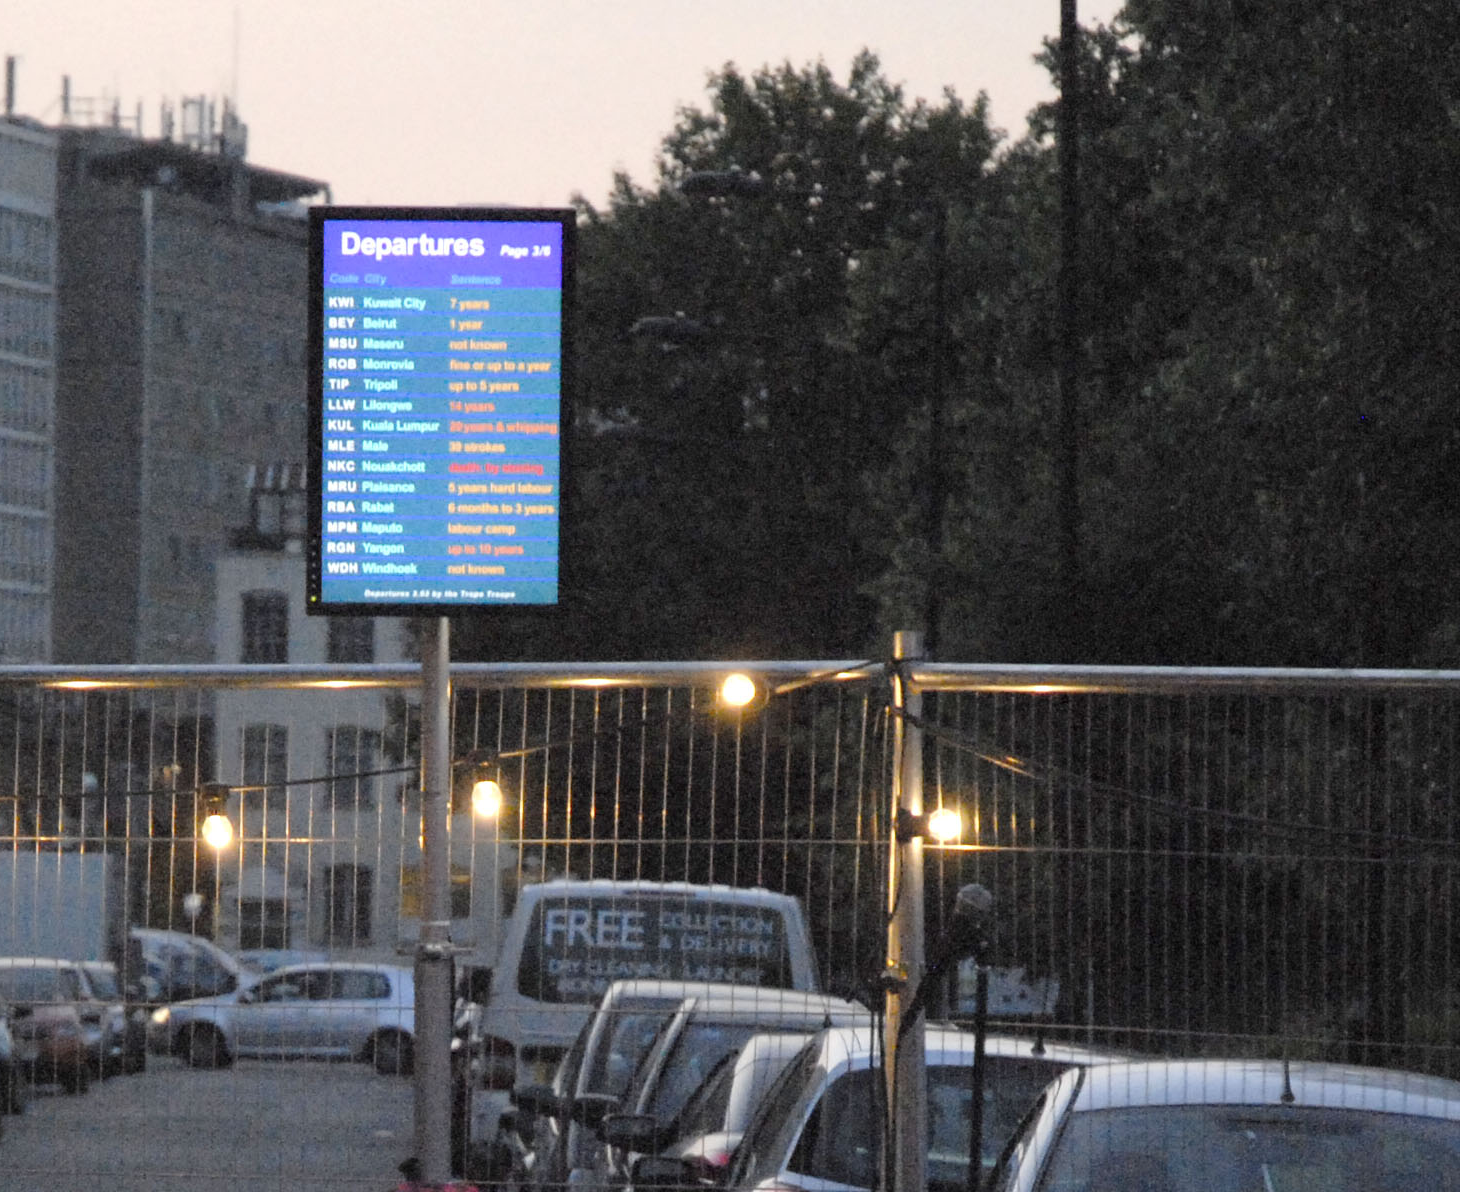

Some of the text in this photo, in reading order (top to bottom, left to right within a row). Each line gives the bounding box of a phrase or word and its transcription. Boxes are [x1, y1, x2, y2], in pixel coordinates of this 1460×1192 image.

[341, 231, 485, 261] Departures
[500, 245, 529, 259] Page
[328, 297, 354, 308] KWI
[363, 297, 402, 308] Kuwait
[403, 297, 427, 311] City
[459, 301, 489, 312] years
[328, 317, 355, 329] BEY
[363, 317, 397, 329] Beirut
[458, 321, 483, 331] year
[328, 337, 508, 350] MSU Maseru not known
[328, 358, 357, 369] ROB
[363, 358, 415, 370] Monrovia
[450, 359, 471, 370] fine
[487, 362, 502, 372] up
[504, 360, 516, 371] to
[527, 362, 551, 373] year
[328, 378, 350, 390] TIP
[363, 378, 398, 392] Tripoli
[449, 382, 463, 393] up
[466, 381, 477, 392] to
[489, 382, 520, 393] years
[328, 399, 355, 411] LLW
[362, 399, 413, 413] Lilongwe
[464, 403, 495, 413] years
[327, 420, 355, 431] KUL
[362, 420, 394, 431] Kuala
[396, 420, 440, 434] Lumpur
[327, 440, 355, 451] MLE
[362, 440, 389, 452] Male
[327, 460, 356, 472] NKC
[362, 460, 426, 473] Nouakchott
[327, 481, 356, 492] MRU
[362, 481, 415, 492] Plaisance
[490, 482, 516, 494] hard
[518, 482, 553, 494] labour
[327, 501, 355, 512] RBA
[362, 501, 395, 513] Rabat
[501, 503, 513, 514] to
[524, 505, 555, 516] years
[327, 521, 516, 536] MPM Maputo labour camp
[327, 542, 356, 553] RGN
[362, 542, 405, 556] Yangon
[448, 545, 462, 556] up
[464, 544, 476, 554] to
[494, 545, 524, 556] years
[327, 562, 505, 574] WDH Windhoek not known
[544, 909, 644, 949] FREE
